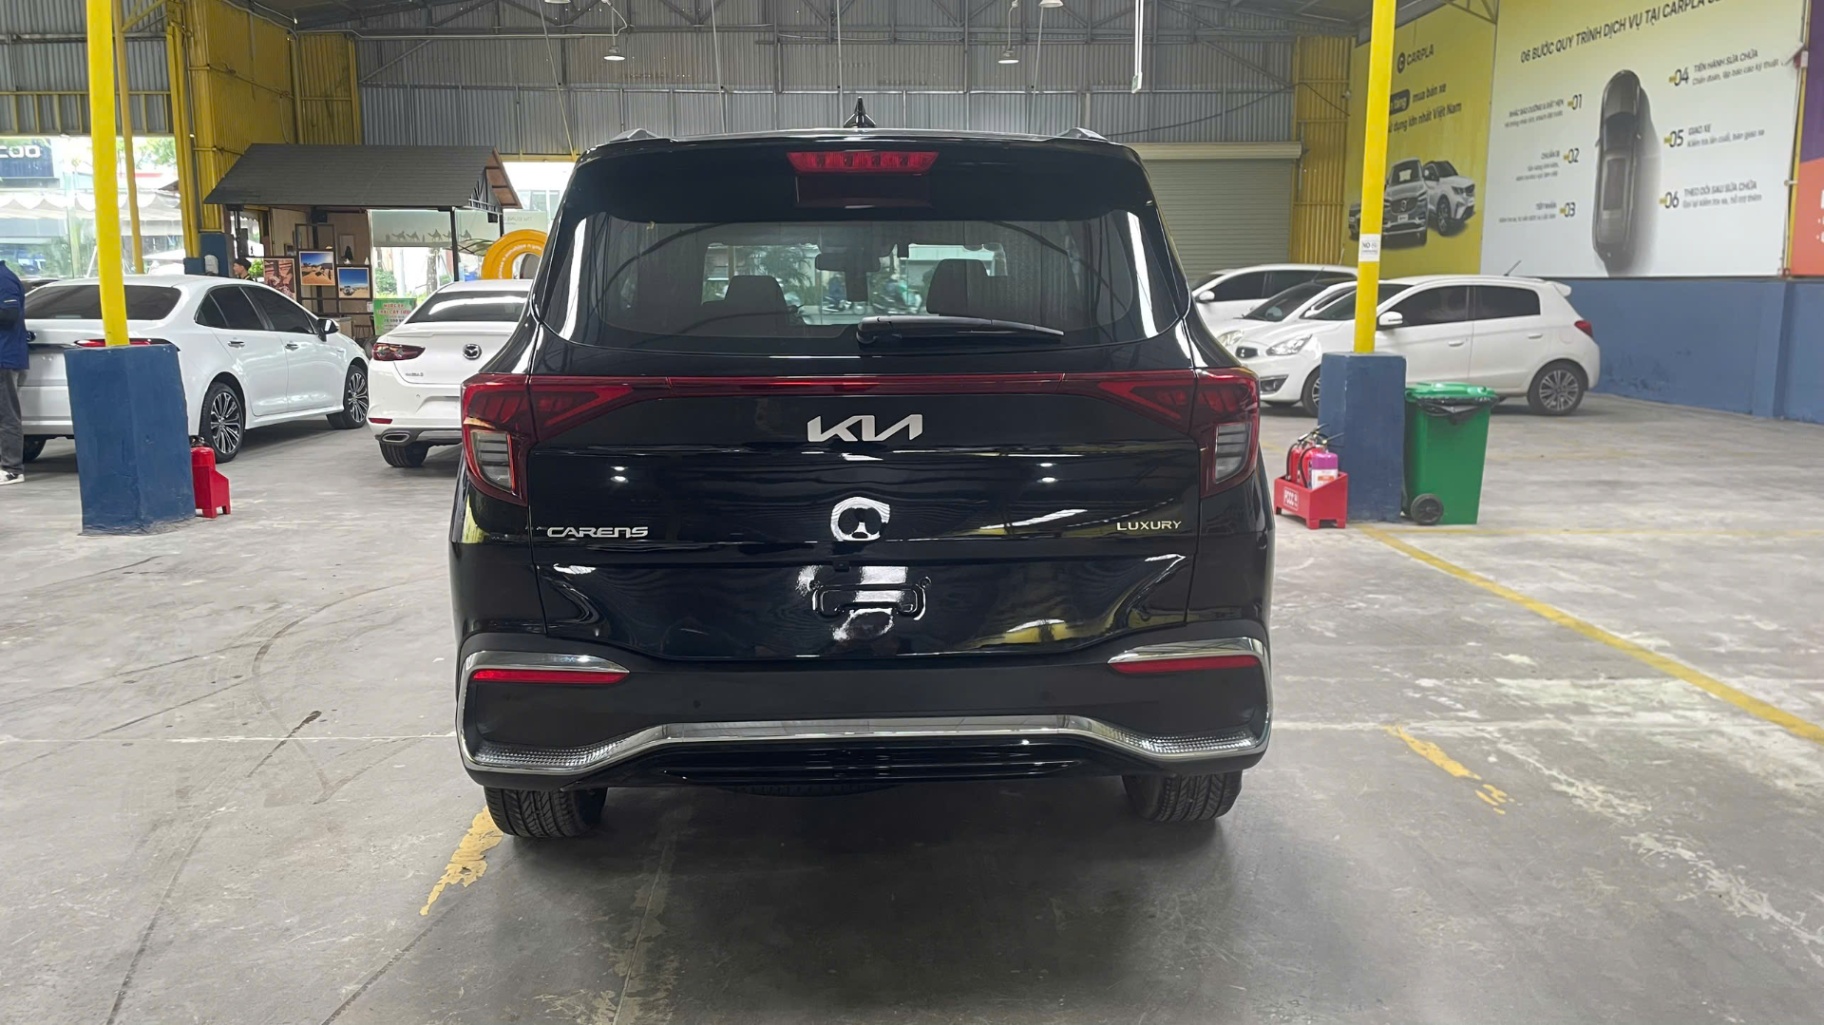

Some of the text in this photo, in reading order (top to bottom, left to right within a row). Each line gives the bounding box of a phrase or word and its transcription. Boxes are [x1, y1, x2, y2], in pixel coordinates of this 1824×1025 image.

[1520, 50, 1530, 63] 06
[1556, 35, 1574, 52] QUY
[1604, 18, 1626, 38] DỊCH
[1628, 12, 1642, 30] VỤ
[1645, 8, 1660, 25] TẠI
[1407, 44, 1434, 66] CARPLA
[1674, 67, 1689, 86] 04
[1446, 103, 1462, 114] Nam
[1572, 94, 1582, 110] 01
[1669, 129, 1684, 148] 05
[1568, 148, 1580, 164] 02
[1664, 190, 1679, 208] 06
[1564, 202, 1576, 218] 03
[807, 414, 923, 442] KIA
[546, 526, 648, 538] CARENS
[1116, 520, 1182, 531] LUXURY
